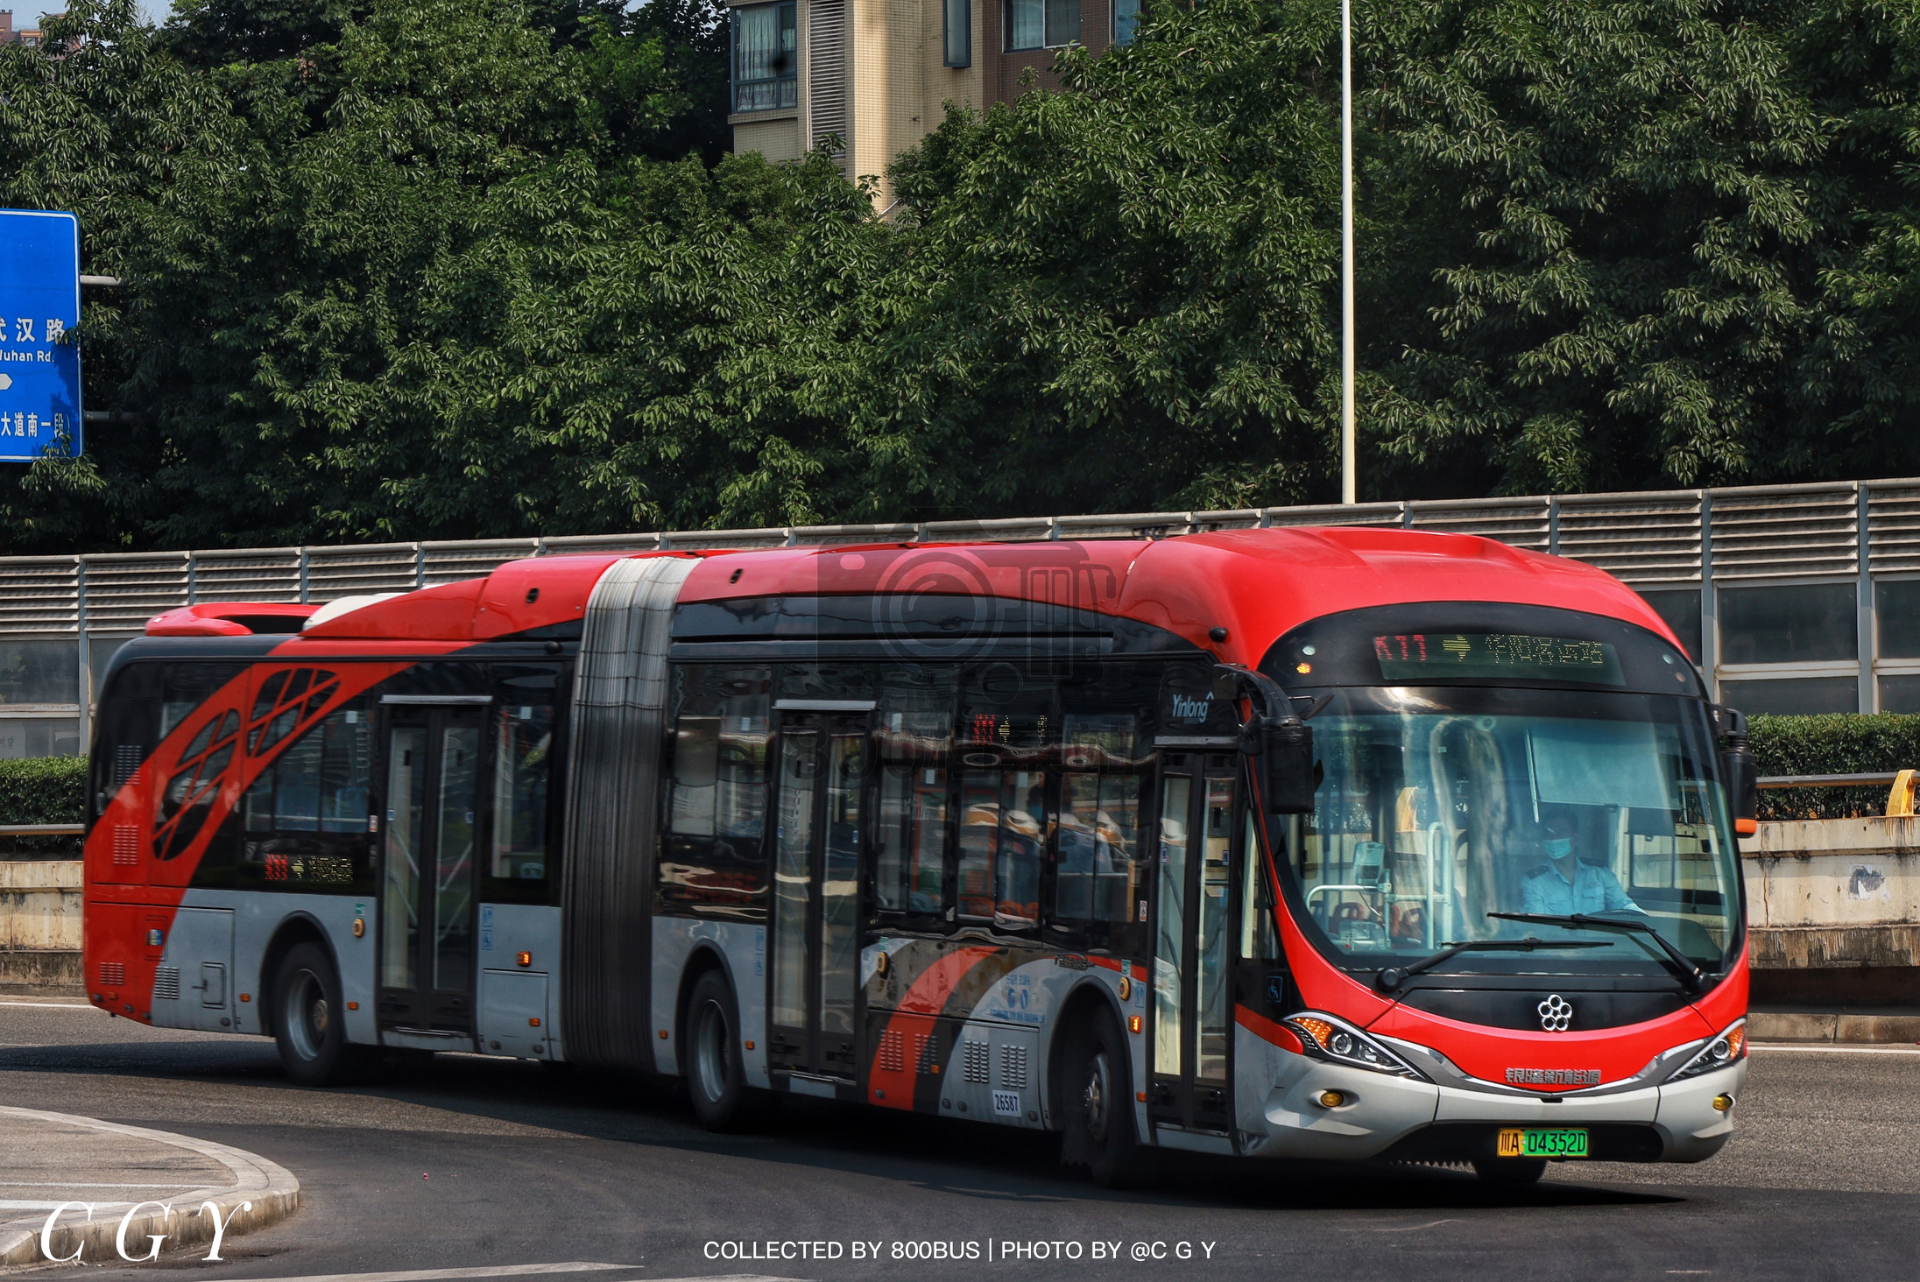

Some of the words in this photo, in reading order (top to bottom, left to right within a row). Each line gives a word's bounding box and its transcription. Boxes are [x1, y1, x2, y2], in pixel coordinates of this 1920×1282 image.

[0, 349, 35, 363] uhan
[37, 350, 55, 363] Rd.
[1172, 693, 1209, 723] Yinlong
[1504, 1067, 1602, 1085] 银隆新能源
[994, 1093, 1020, 1114] 26587
